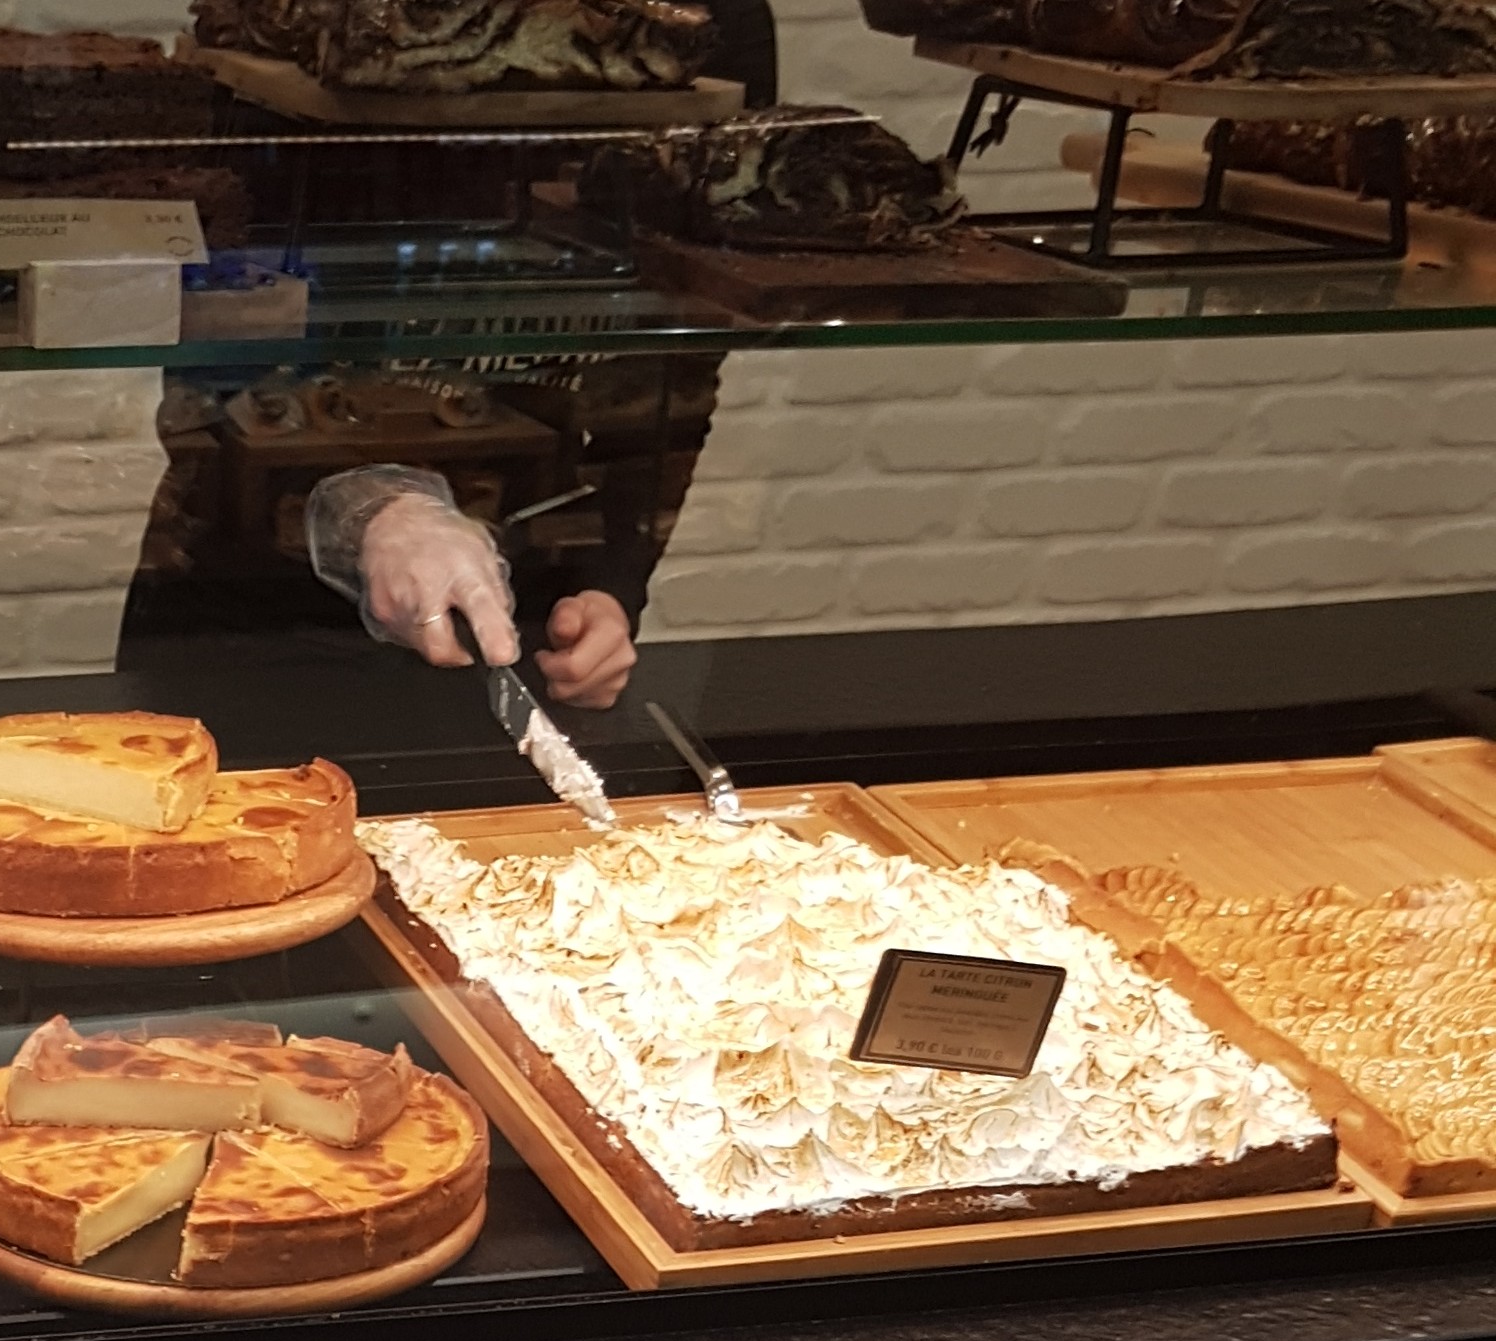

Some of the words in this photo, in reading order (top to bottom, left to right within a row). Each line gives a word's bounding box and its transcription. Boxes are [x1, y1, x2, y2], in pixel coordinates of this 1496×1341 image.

[918, 968, 937, 979] LA
[940, 969, 983, 982] TARTE
[983, 974, 1033, 989] CITRON
